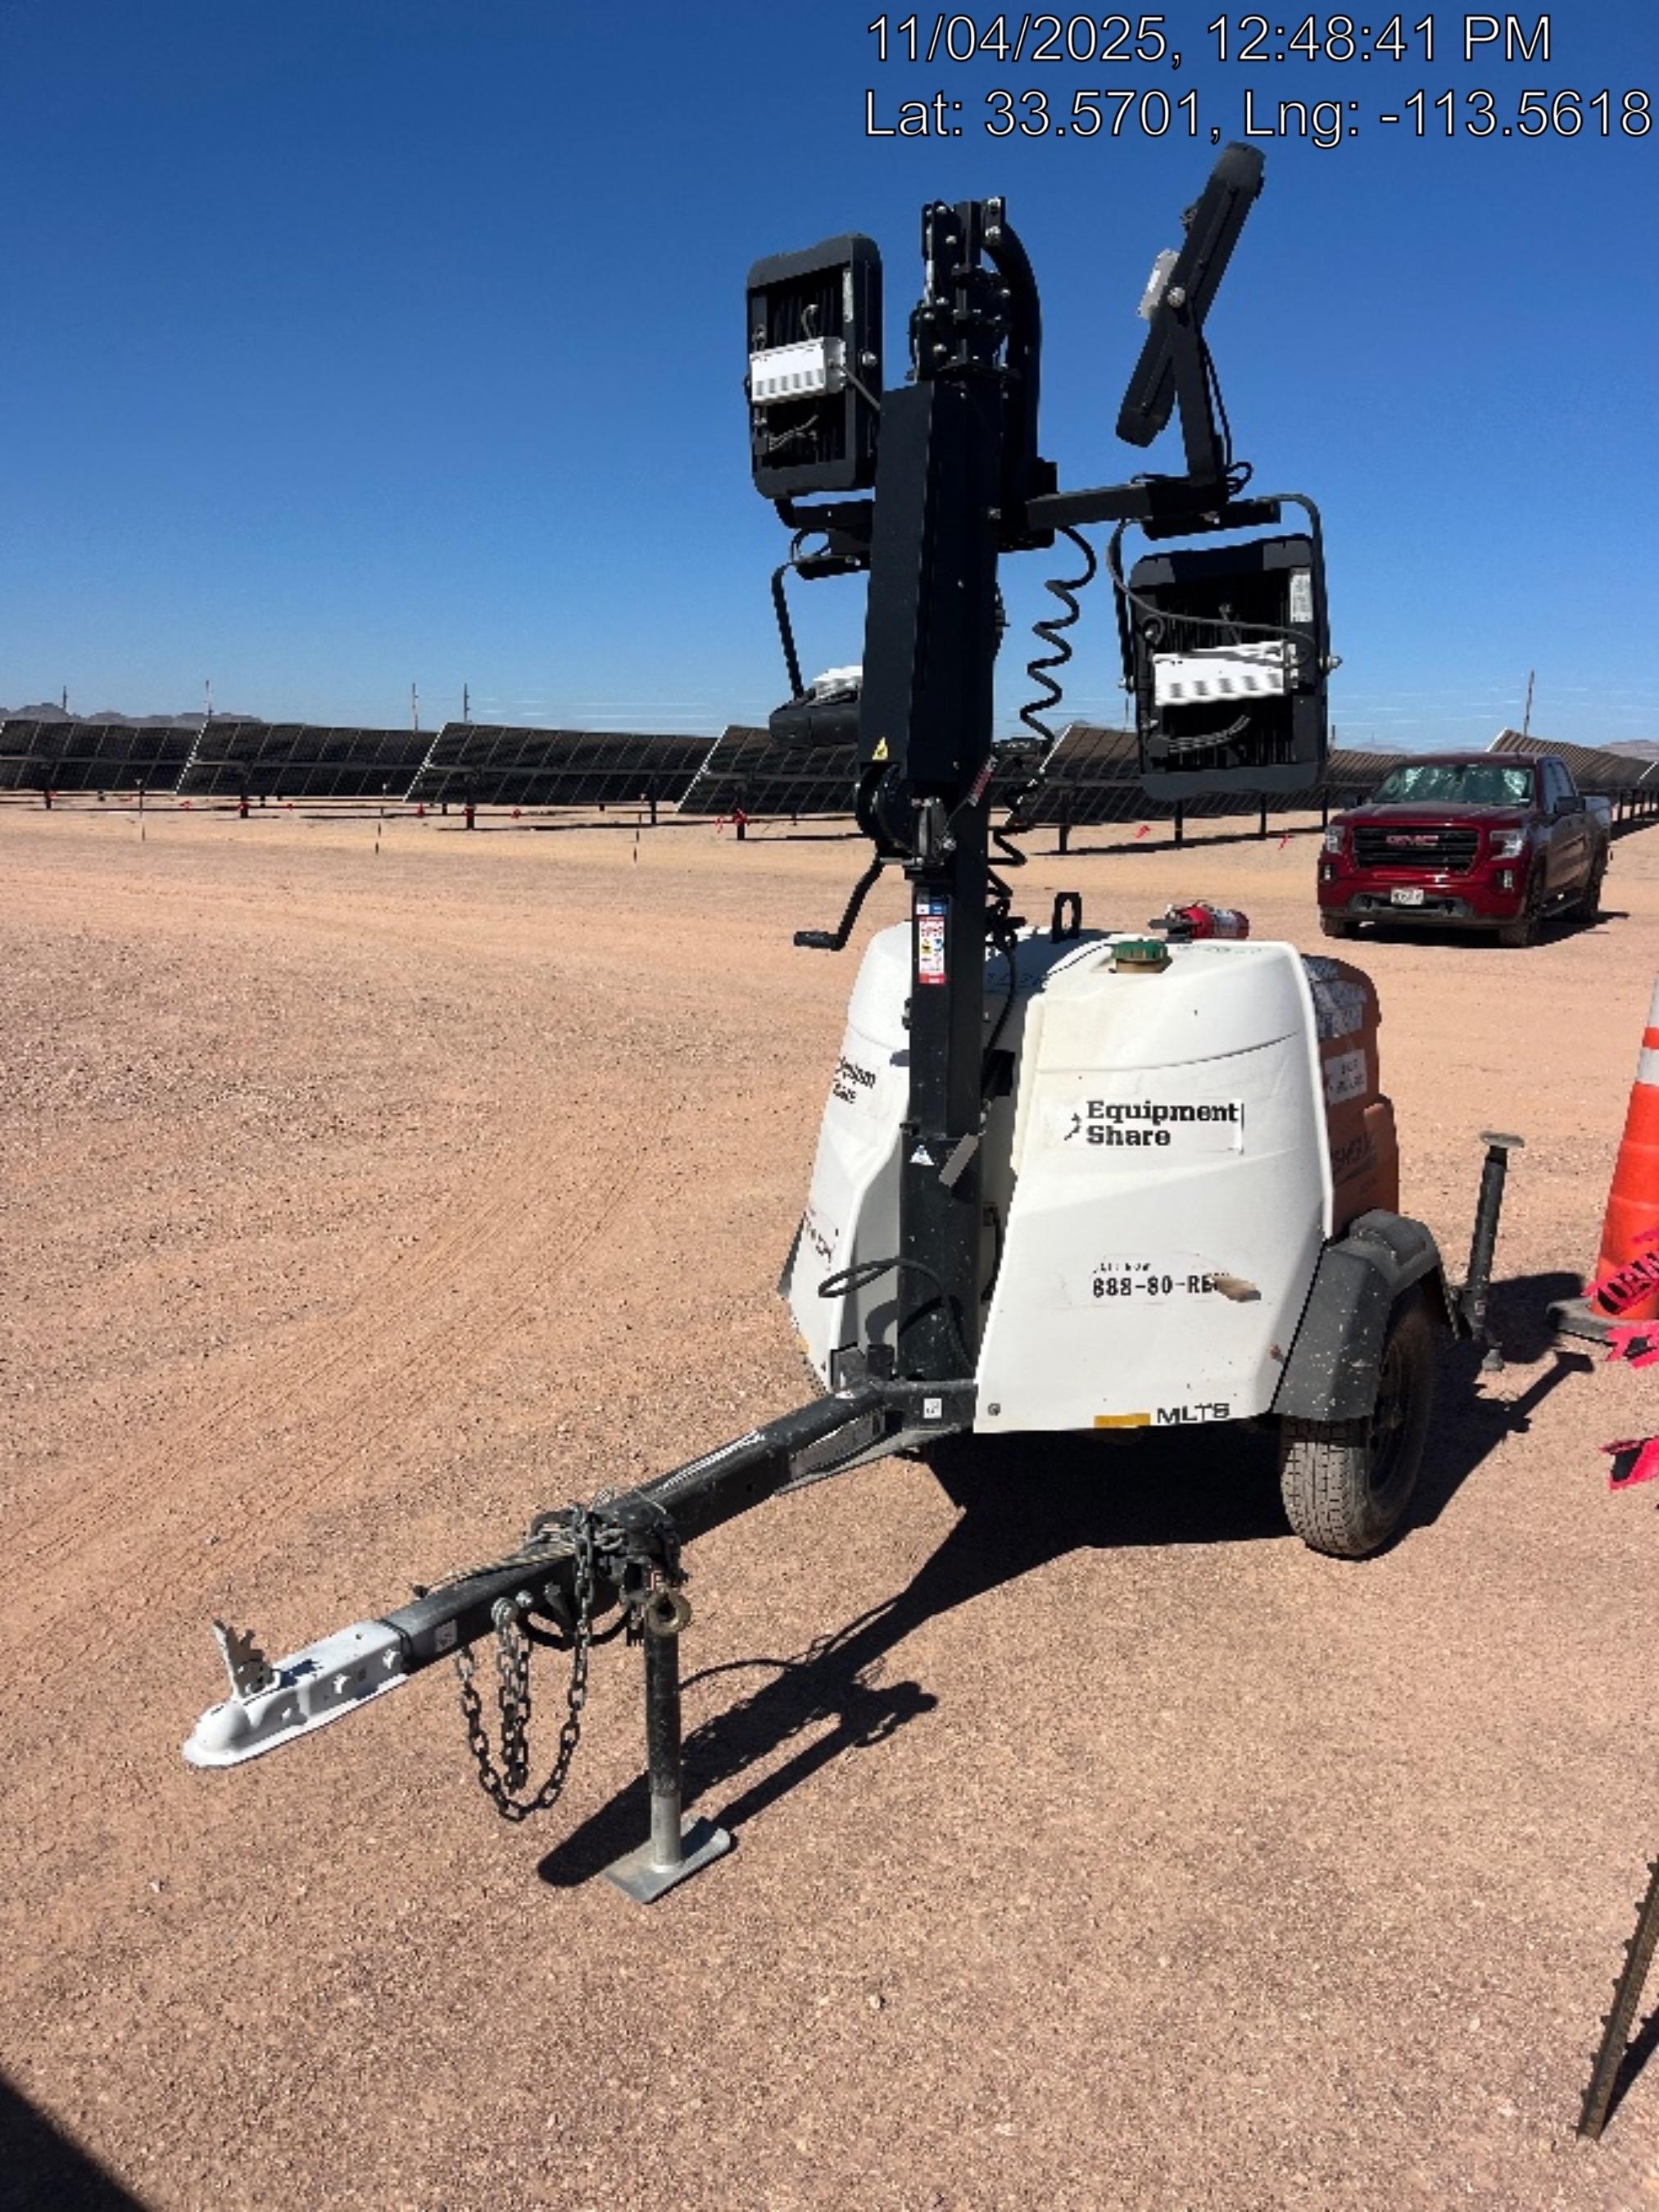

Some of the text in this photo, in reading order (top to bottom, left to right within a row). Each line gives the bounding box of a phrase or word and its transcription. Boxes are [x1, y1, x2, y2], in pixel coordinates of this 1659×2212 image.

[1086, 1099, 1239, 1126] Equipment
[1086, 1124, 1172, 1147] Share
[1093, 1274, 1231, 1298] 888-80-RE
